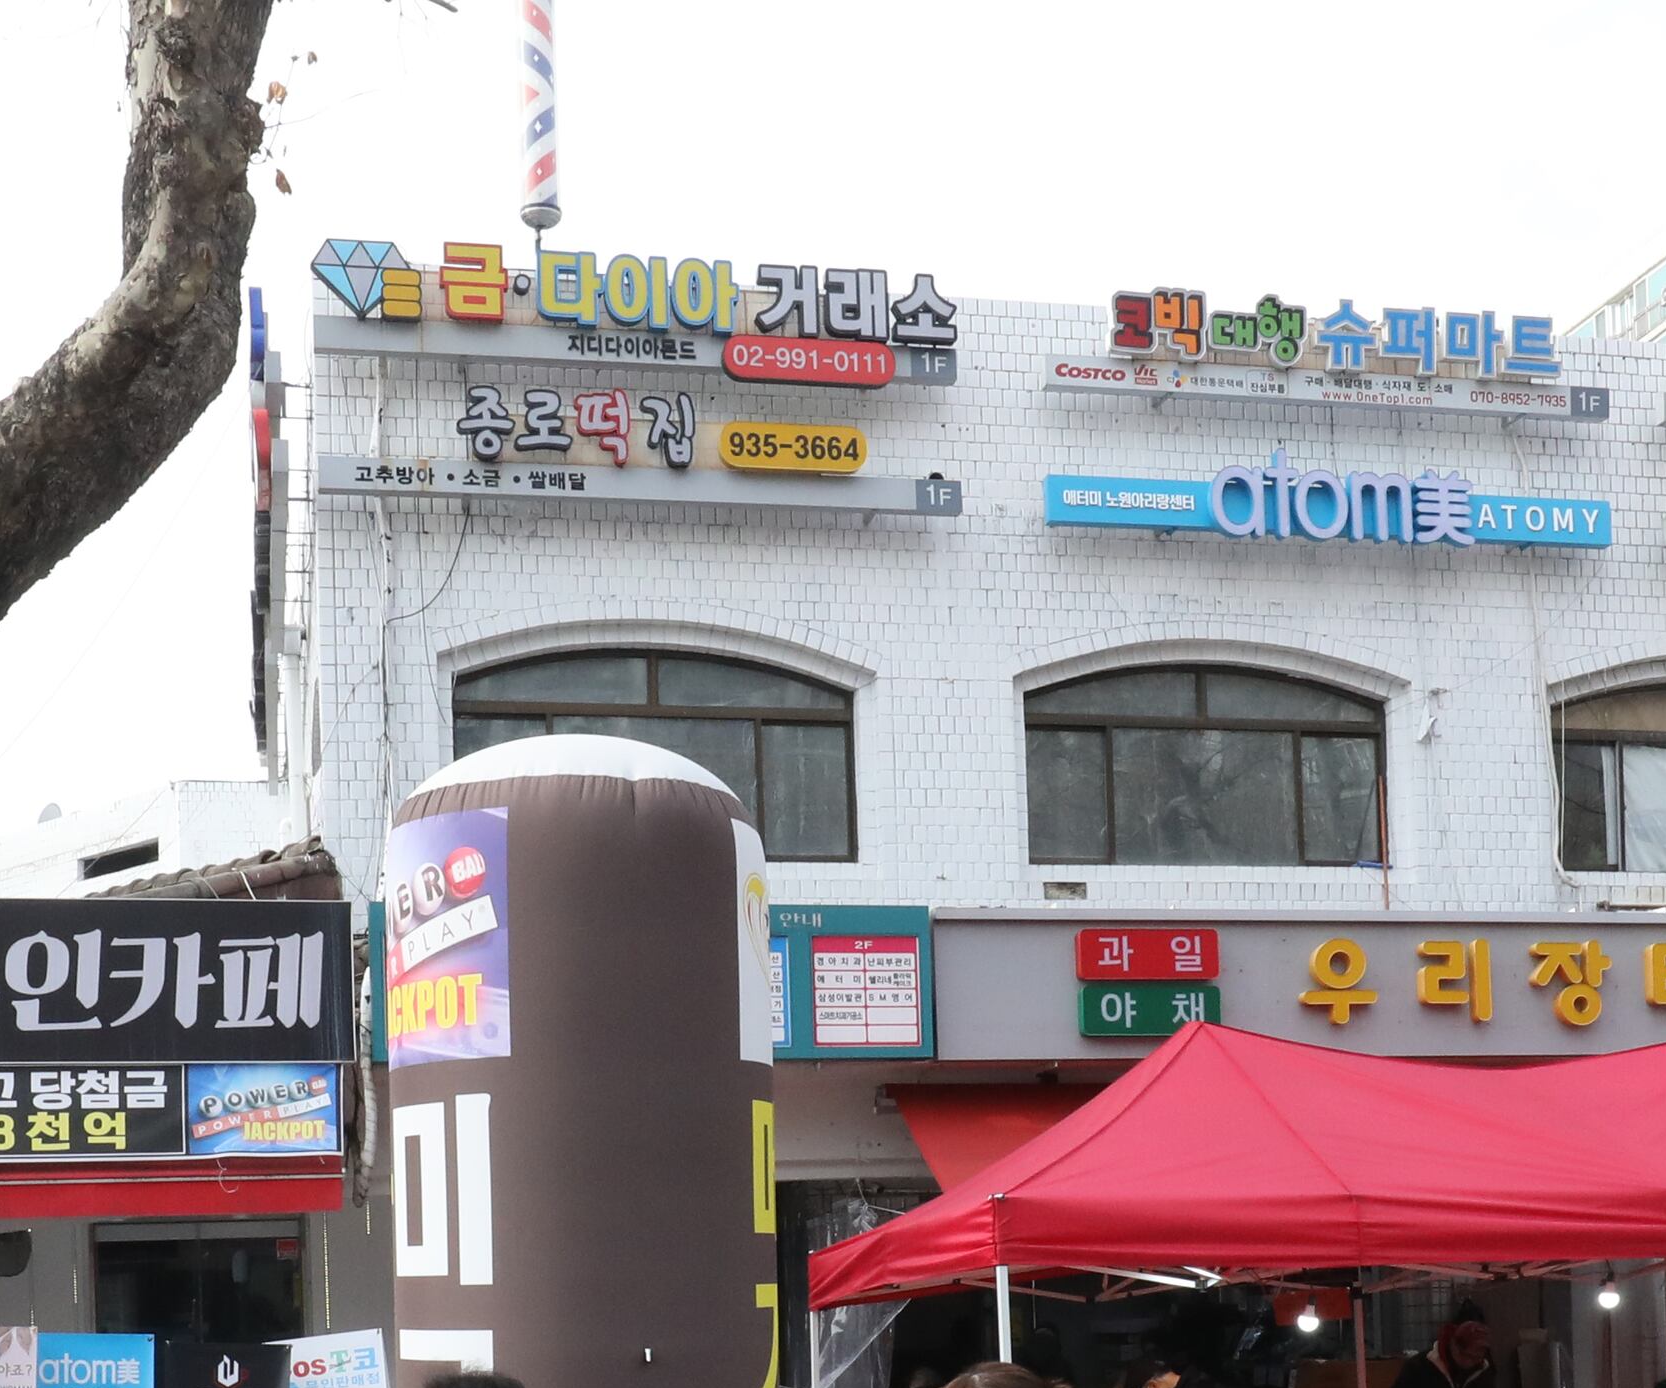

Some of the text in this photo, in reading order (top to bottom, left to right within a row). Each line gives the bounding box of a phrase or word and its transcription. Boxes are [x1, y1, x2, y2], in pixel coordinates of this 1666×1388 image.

[754, 262, 958, 345] 거래소
[567, 336, 697, 361] 지디다이아몬드
[1317, 298, 1562, 377] 슈퍼마트
[733, 344, 887, 375] 02-991-0111
[921, 354, 947, 374] 1F
[1055, 363, 1125, 381] COSTCO
[1260, 373, 1274, 381] TS
[1334, 378, 1372, 390] 배달대행
[1382, 380, 1410, 392] 식자재
[1470, 391, 1566, 408] 070-8952-7935
[1579, 392, 1600, 412] 1F
[457, 385, 695, 468] 종로떡집
[729, 431, 859, 461] 935-3664
[355, 467, 587, 491] 고추방아 소금 쌀배달
[925, 486, 952, 506] 1F
[1063, 491, 1195, 513] 애터미 노원아리랑센터
[1479, 503, 1598, 533] ATOMY
[780, 913, 821, 927] 안내
[407, 910, 475, 961] PLAY
[854, 941, 873, 949] 2F
[867, 958, 911, 967] 난피부관리
[1096, 933, 1205, 972] 과일
[388, 974, 482, 1040] CKPOT
[818, 993, 862, 1002] 삼성이발관
[1099, 989, 1205, 1028] 야채
[32, 1071, 168, 1110] 당첨금
[203, 1081, 309, 1114] POWER
[244, 1120, 325, 1141] JACKPOT
